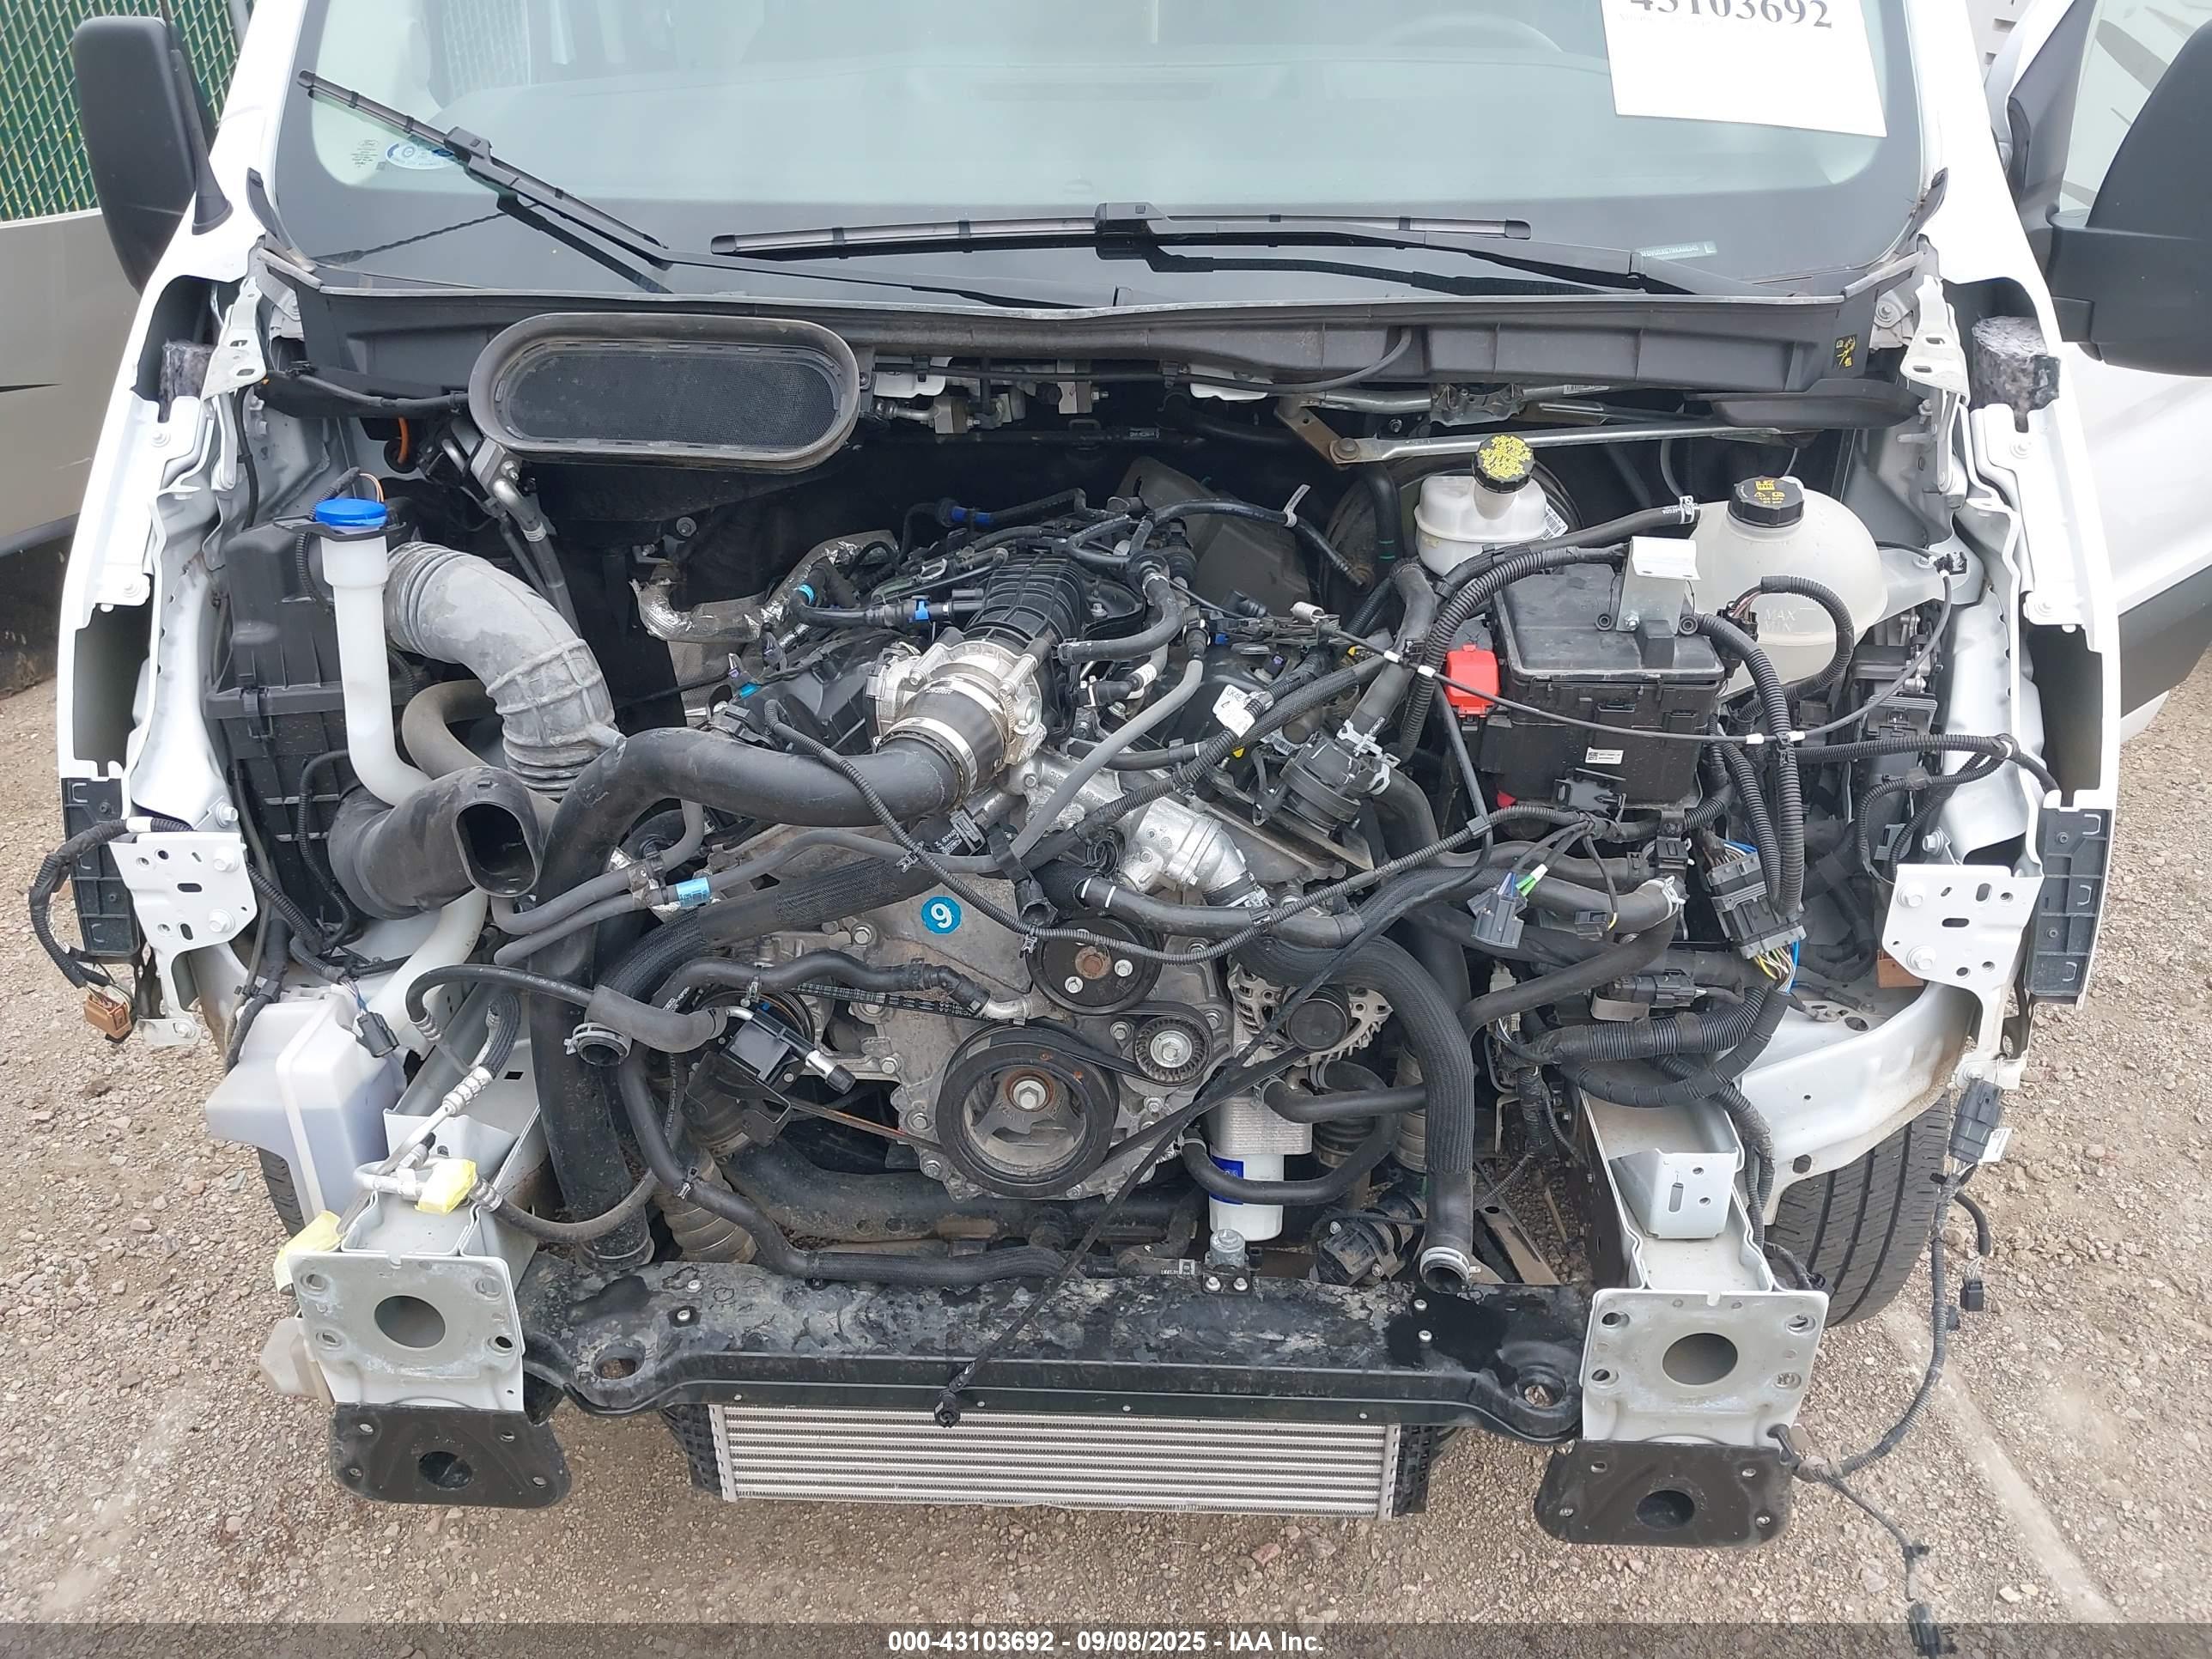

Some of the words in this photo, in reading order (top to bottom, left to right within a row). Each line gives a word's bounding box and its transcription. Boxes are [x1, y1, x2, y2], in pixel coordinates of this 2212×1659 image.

[1765, 609, 1796, 621] MAX
[1765, 622, 1791, 633] MIN
[930, 902, 953, 929] 9
